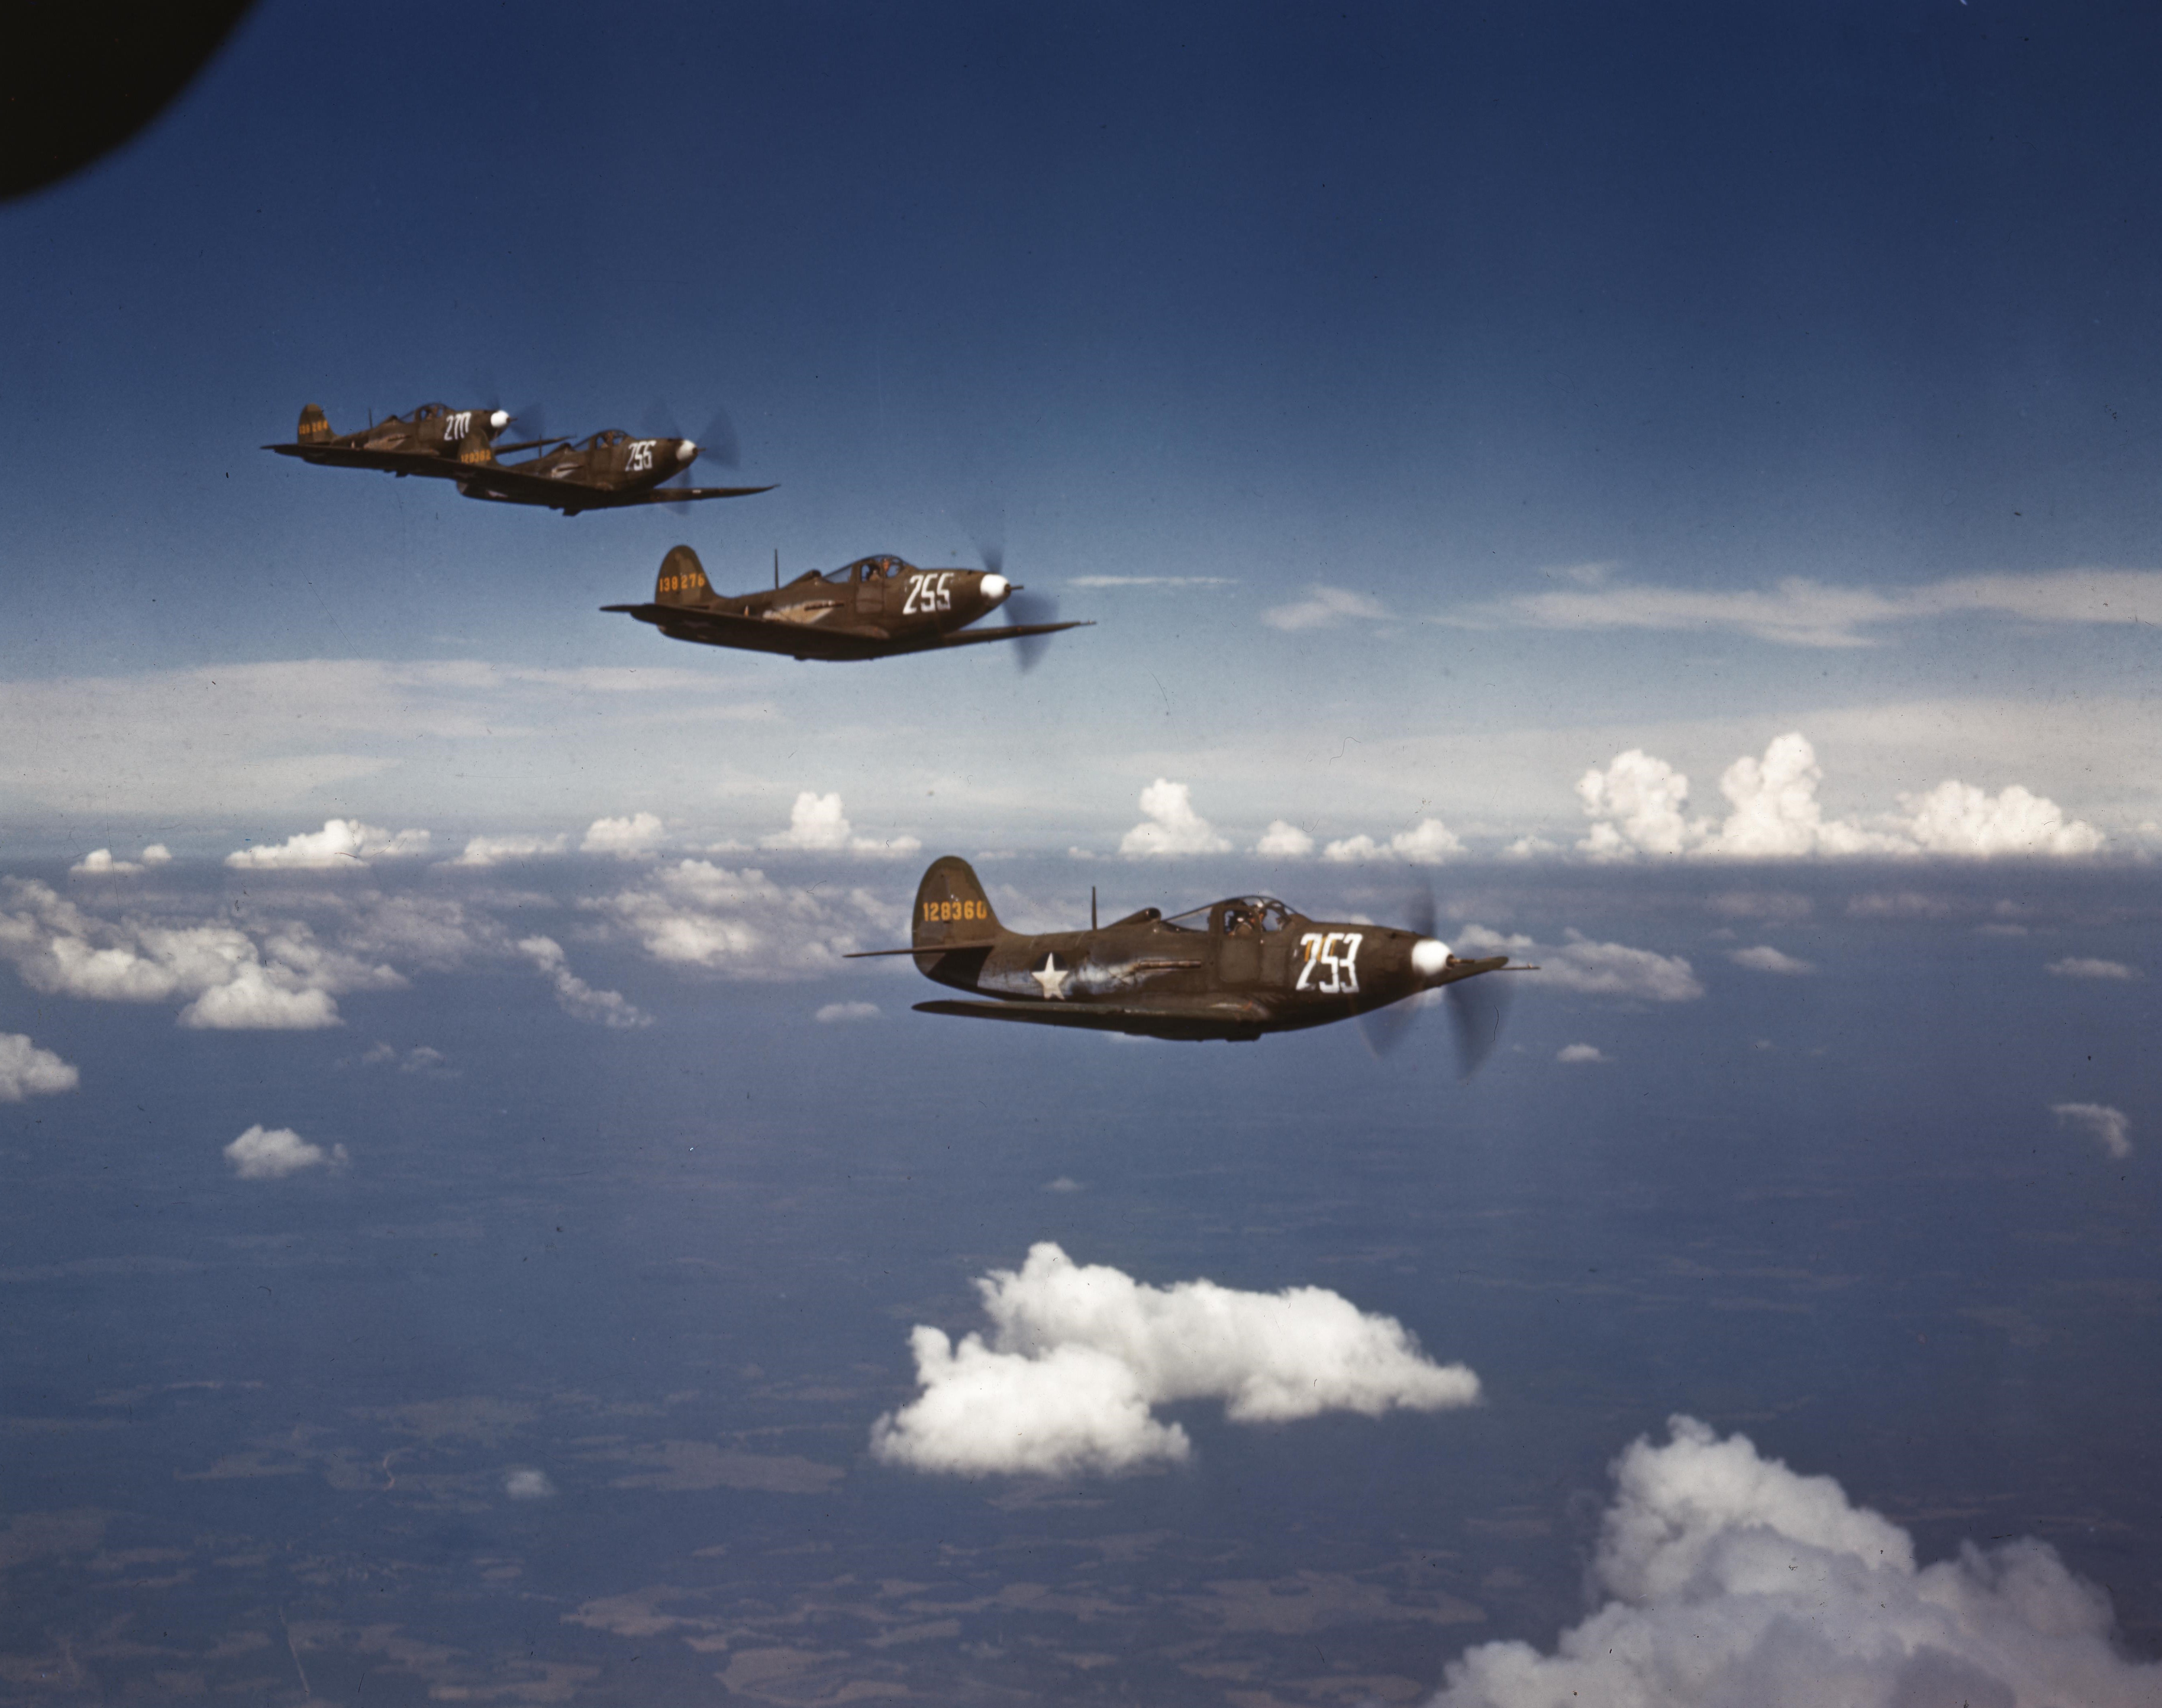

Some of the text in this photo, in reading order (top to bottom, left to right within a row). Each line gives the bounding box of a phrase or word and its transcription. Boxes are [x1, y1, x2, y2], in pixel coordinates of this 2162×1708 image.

[659, 573, 705, 592] 138276
[903, 573, 954, 615] 255
[923, 900, 987, 922] 128360
[1296, 932, 1363, 993] 253
